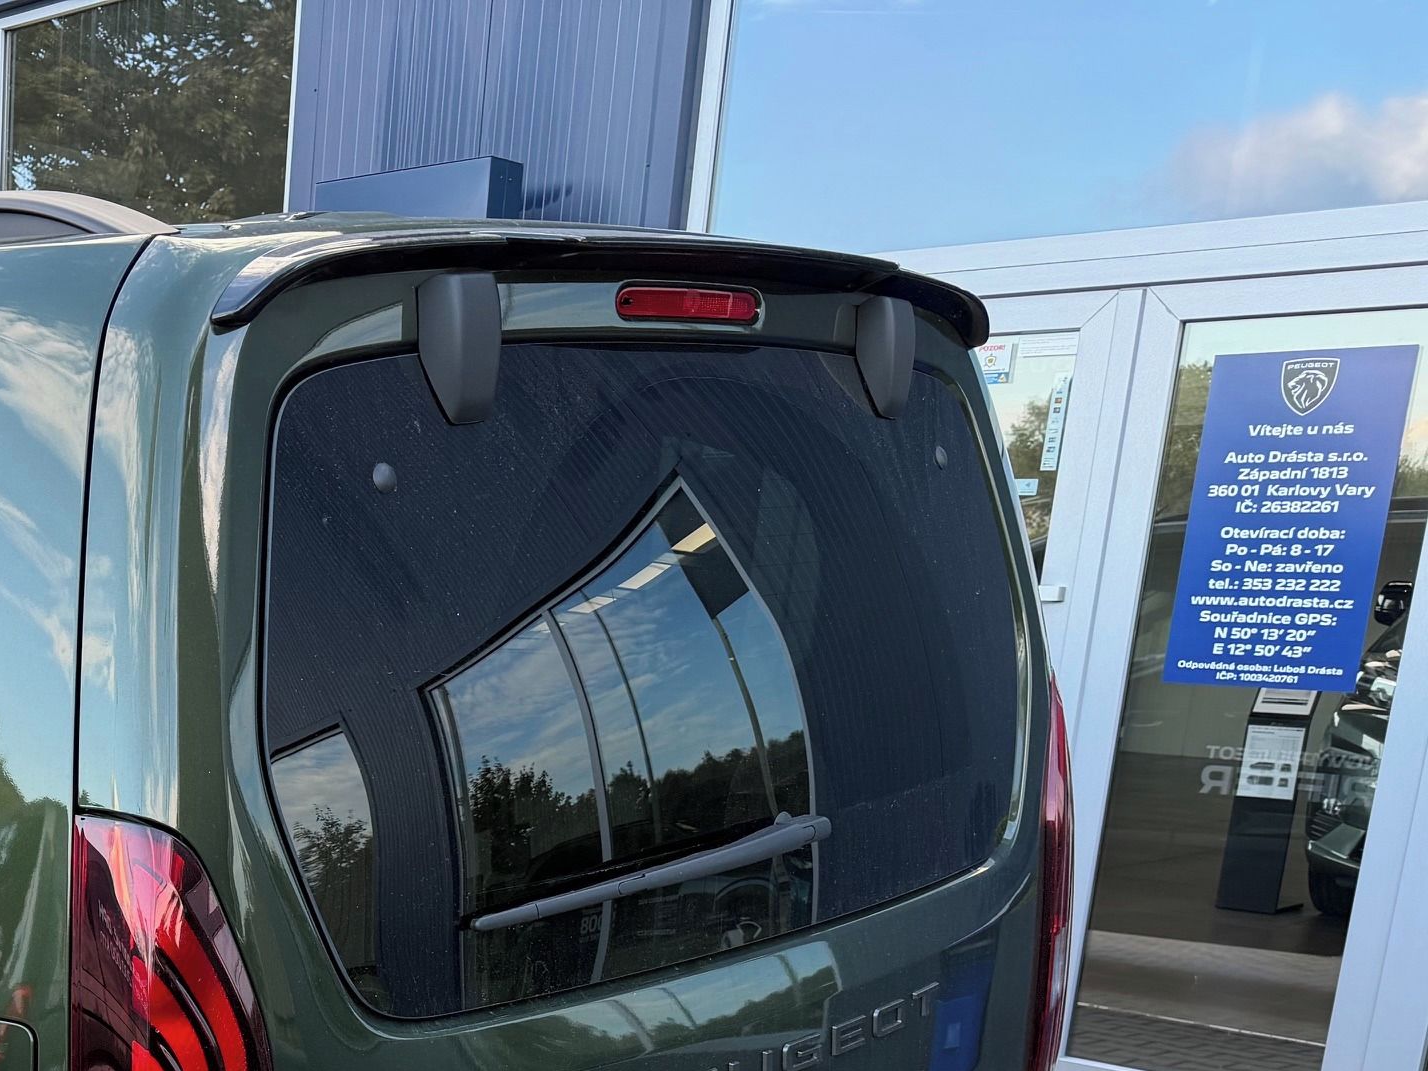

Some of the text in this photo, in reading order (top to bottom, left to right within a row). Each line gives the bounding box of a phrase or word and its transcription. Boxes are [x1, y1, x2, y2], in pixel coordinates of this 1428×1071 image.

[1287, 362, 1335, 370] PEUGEOT
[1248, 422, 1354, 439] Vítejte u nás
[1224, 450, 1368, 464] Auto Drásta s.r.o.
[1238, 466, 1349, 482] Západní 1813
[1207, 483, 1376, 499] 360 01 Karlovy Vary
[1235, 499, 1340, 513] IČ: 26382261
[1220, 526, 1346, 540] Otevírací doba:
[1225, 544, 1248, 556] Po
[1259, 543, 1287, 556] Pá:
[1290, 544, 1302, 556] 8
[1314, 544, 1335, 557] 17
[1210, 560, 1232, 572] So
[1244, 560, 1272, 573] Ne:
[1275, 561, 1344, 574] zavřeno
[1208, 577, 1341, 592] tel.: 353 232 222
[1190, 595, 1354, 609] www.autodrasta.cz
[1199, 610, 1337, 626] Souřadnice GPS:
[1214, 627, 1228, 638] N
[1230, 628, 1258, 640] 50°
[1212, 643, 1224, 655] E
[1227, 643, 1253, 656] 12°
[1177, 660, 1343, 676] Odpovědná osoba: Luboš Drásta
[1215, 671, 1299, 684] IČP: 1003420761
